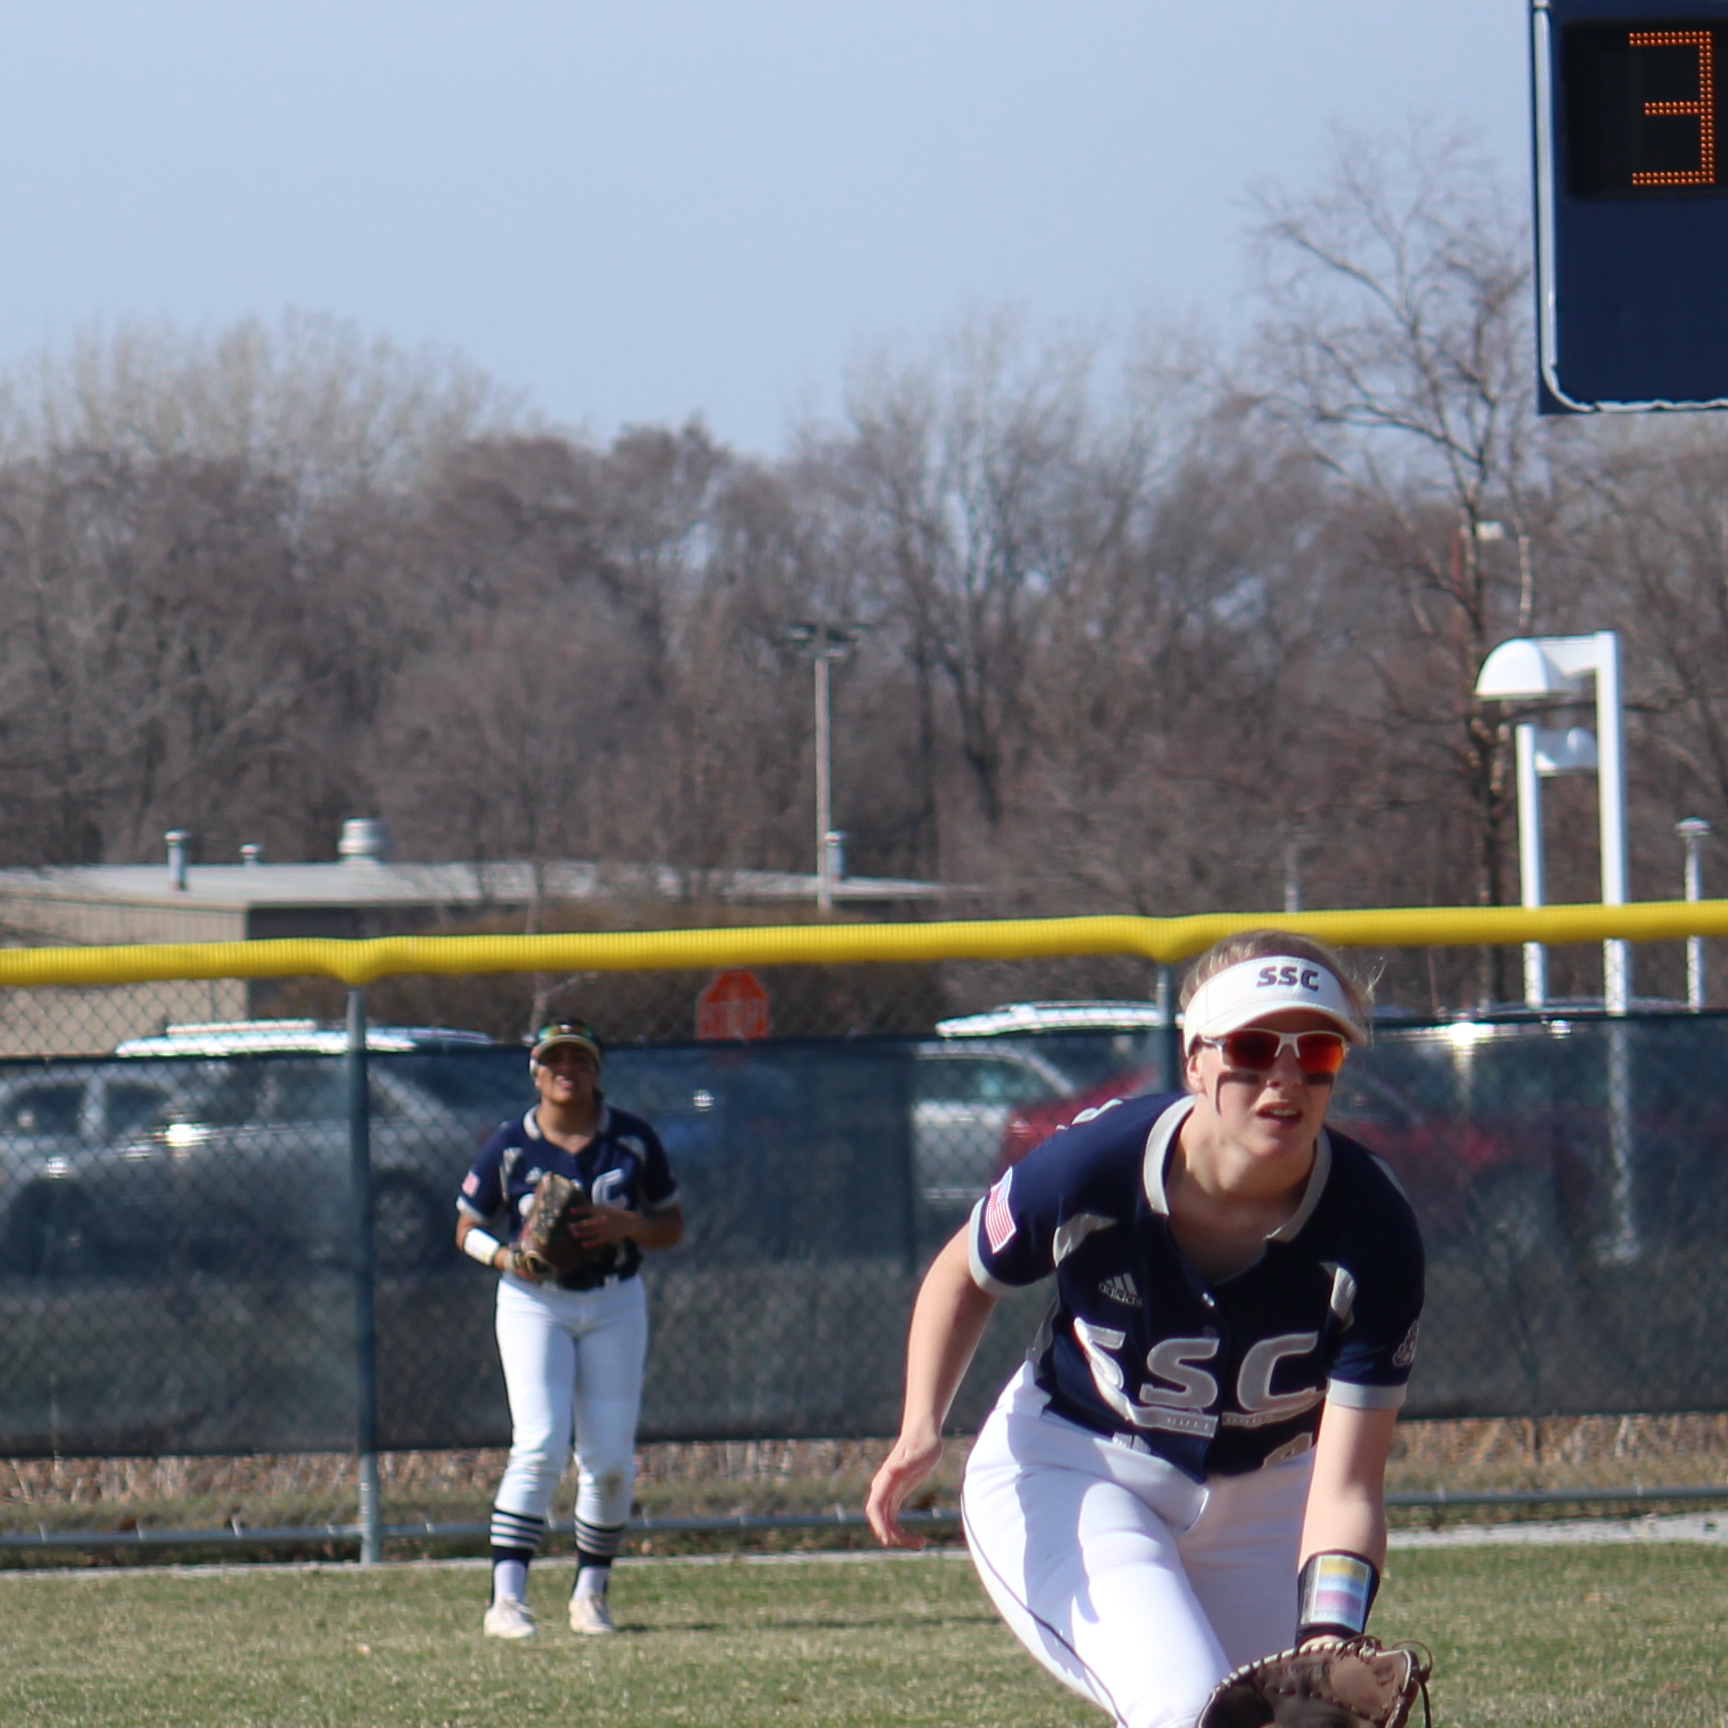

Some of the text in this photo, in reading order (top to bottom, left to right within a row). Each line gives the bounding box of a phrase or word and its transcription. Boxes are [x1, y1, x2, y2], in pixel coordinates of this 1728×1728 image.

[1629, 31, 1715, 186] 3
[1256, 966, 1319, 992] SSC
[1074, 1317, 1319, 1412] SSC
